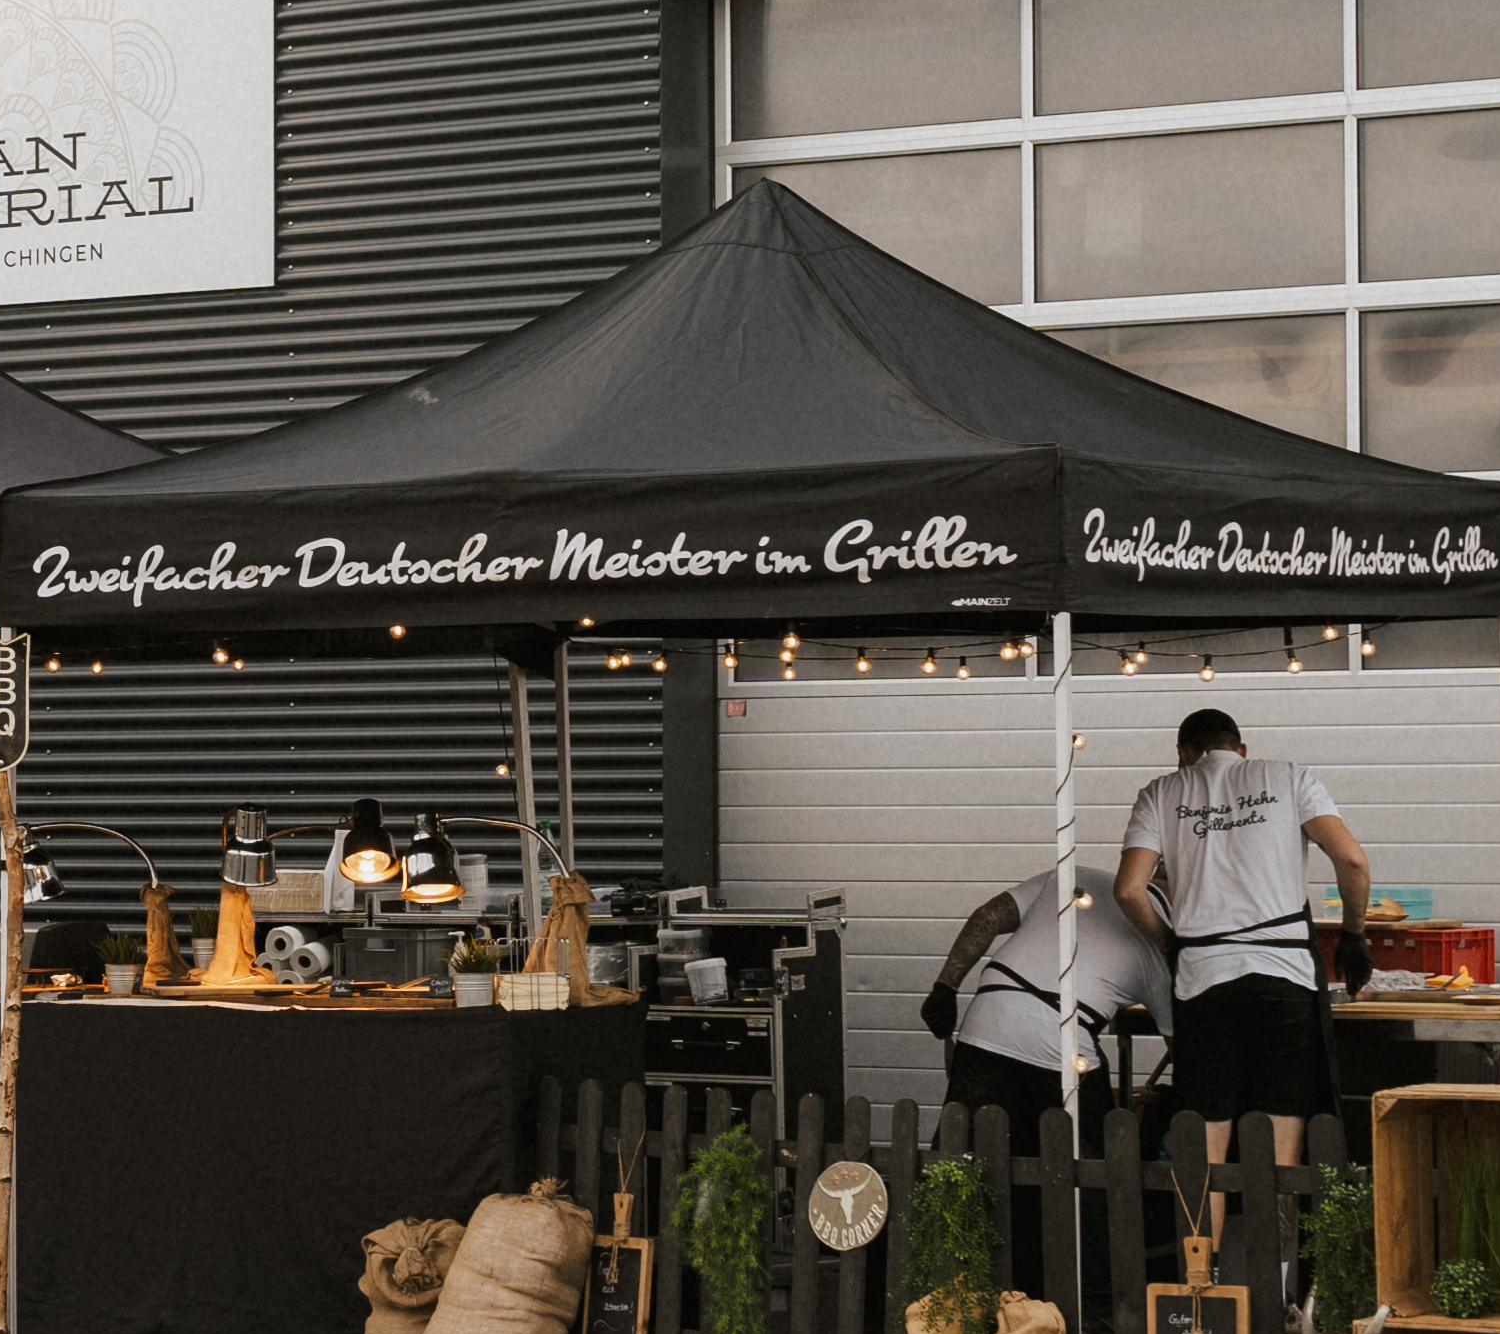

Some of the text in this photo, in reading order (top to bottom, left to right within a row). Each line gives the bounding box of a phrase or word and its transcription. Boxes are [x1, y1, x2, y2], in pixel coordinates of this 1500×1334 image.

[34, 515, 1018, 607] Zweifacher Deutscher Meister im Grillen
[1083, 508, 1499, 584] Zweifacher Deutscher Meister im Grillen
[1236, 790, 1279, 810] Hehn
[815, 1203, 885, 1247] BBQ CORNER
